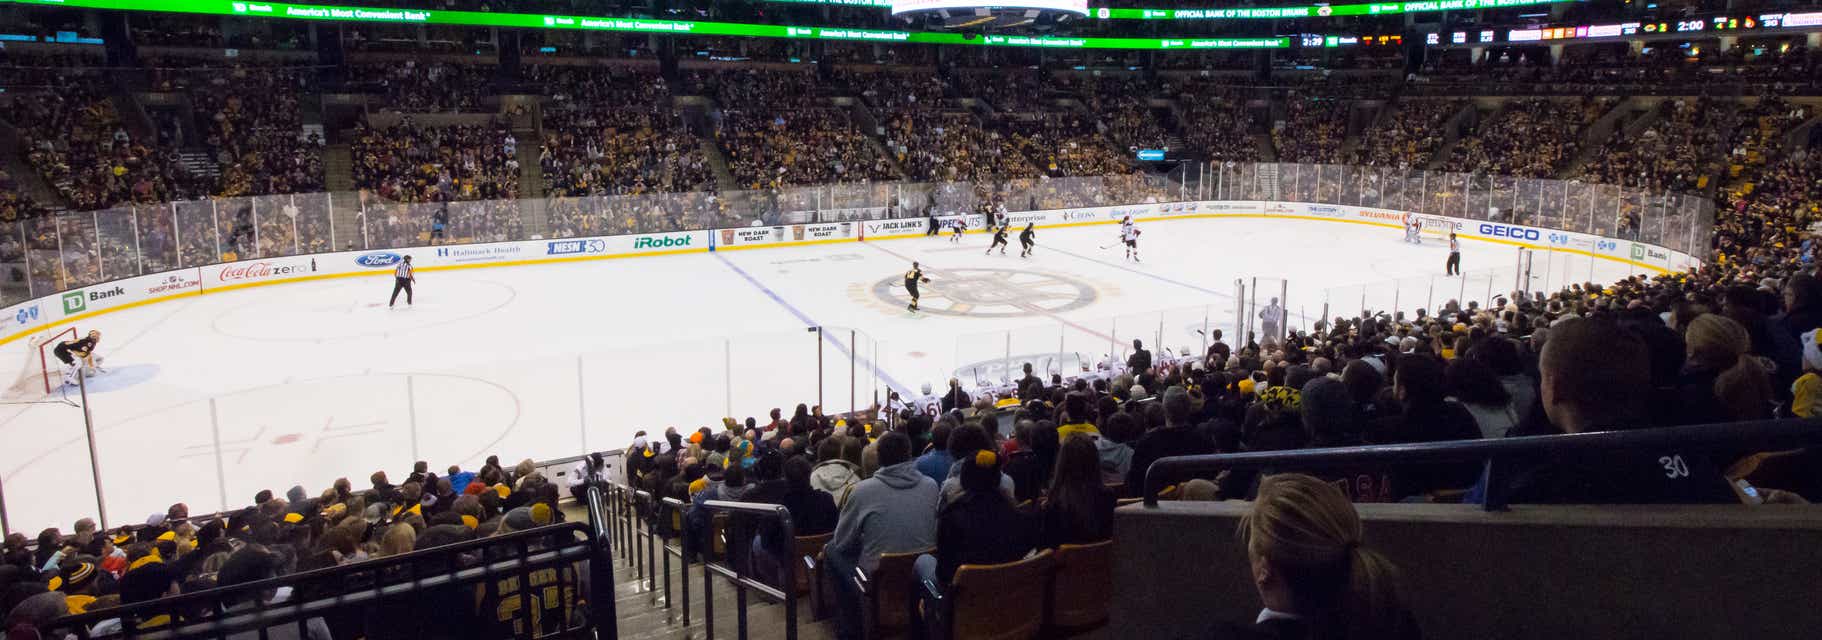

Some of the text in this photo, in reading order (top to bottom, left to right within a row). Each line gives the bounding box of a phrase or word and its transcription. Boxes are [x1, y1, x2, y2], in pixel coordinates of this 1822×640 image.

[1405, 2, 1438, 12] OFFICIAL
[1440, 1, 1463, 10] BANK
[1464, 0, 1477, 9] OF
[287, 7, 330, 16] America's
[331, 8, 354, 18] Most
[355, 10, 404, 20] Convenient
[1175, 7, 1308, 18] OFFICIAL BANK OF THE BOSTON BRUINS
[581, 19, 615, 28] America's
[615, 20, 634, 28] Most
[634, 22, 673, 30] Convenient
[1658, 23, 1668, 33] 2
[1677, 21, 1705, 31] 2:00
[1728, 19, 1738, 29] 2
[820, 29, 846, 38] America's
[847, 30, 862, 38] Most
[862, 31, 893, 39] Convenient
[1303, 38, 1323, 46] 3:39
[1007, 215, 1046, 225] nterprise
[1359, 209, 1399, 222] SYLVANIA
[900, 221, 923, 229] LINK'S
[1479, 223, 1540, 241] GEICO
[634, 234, 692, 249] iRobot
[452, 247, 522, 257] Hallmark Health
[554, 242, 582, 254] NESN
[1647, 248, 1668, 261] Bank
[364, 255, 394, 268] Ford
[273, 262, 307, 275] zero
[90, 286, 125, 302] Bank
[926, 402, 942, 418] 61
[1658, 454, 1690, 479] 30
